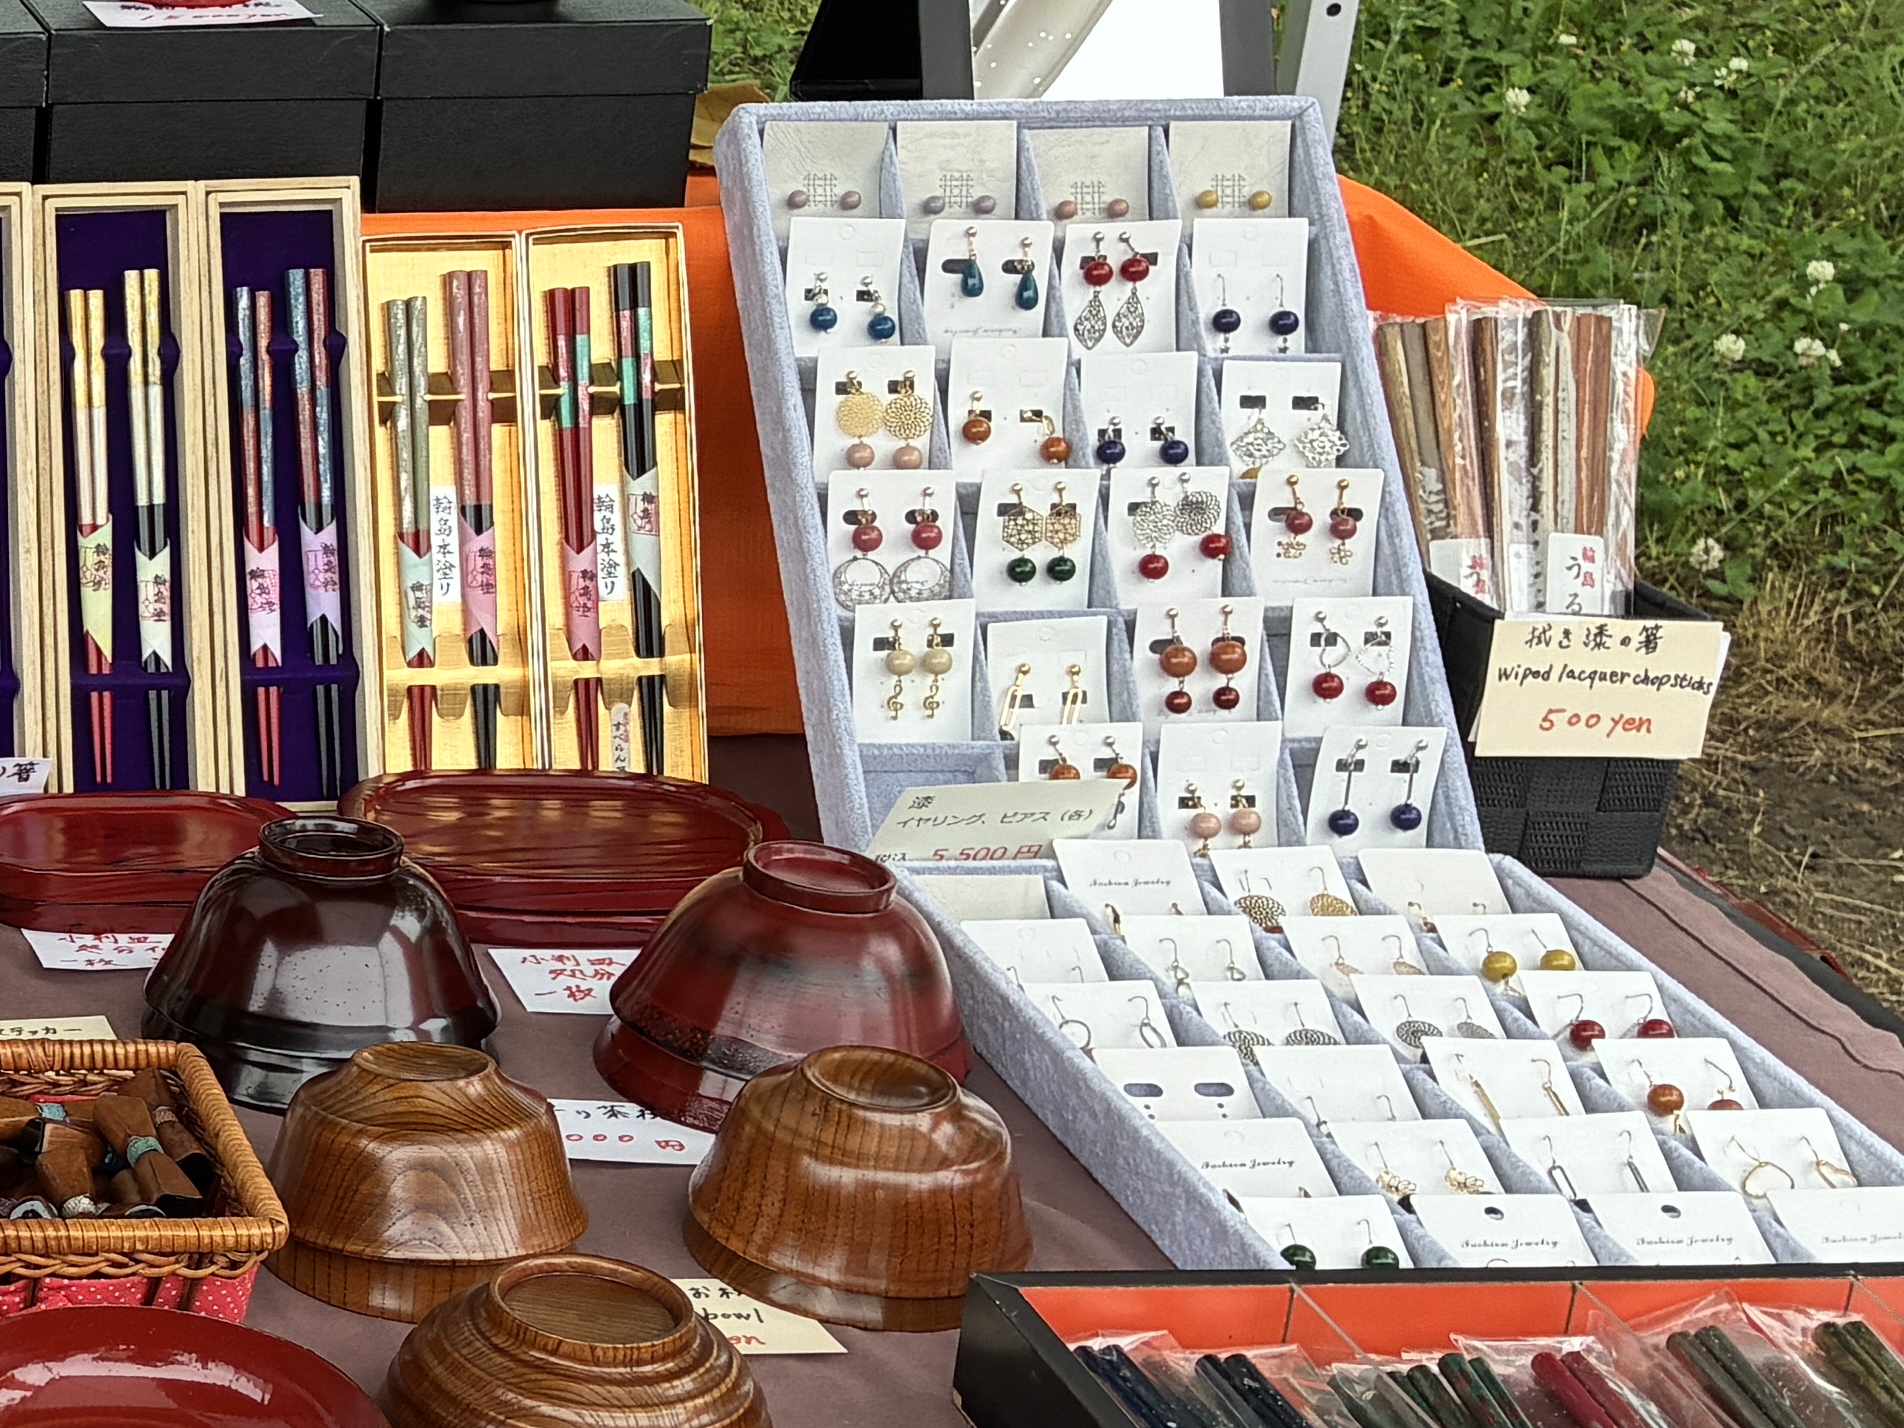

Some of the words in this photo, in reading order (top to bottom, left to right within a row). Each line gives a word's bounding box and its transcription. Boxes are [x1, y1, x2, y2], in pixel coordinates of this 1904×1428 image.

[1525, 622, 1663, 655] 拭き漆の箸
[1539, 708, 1601, 732] 500
